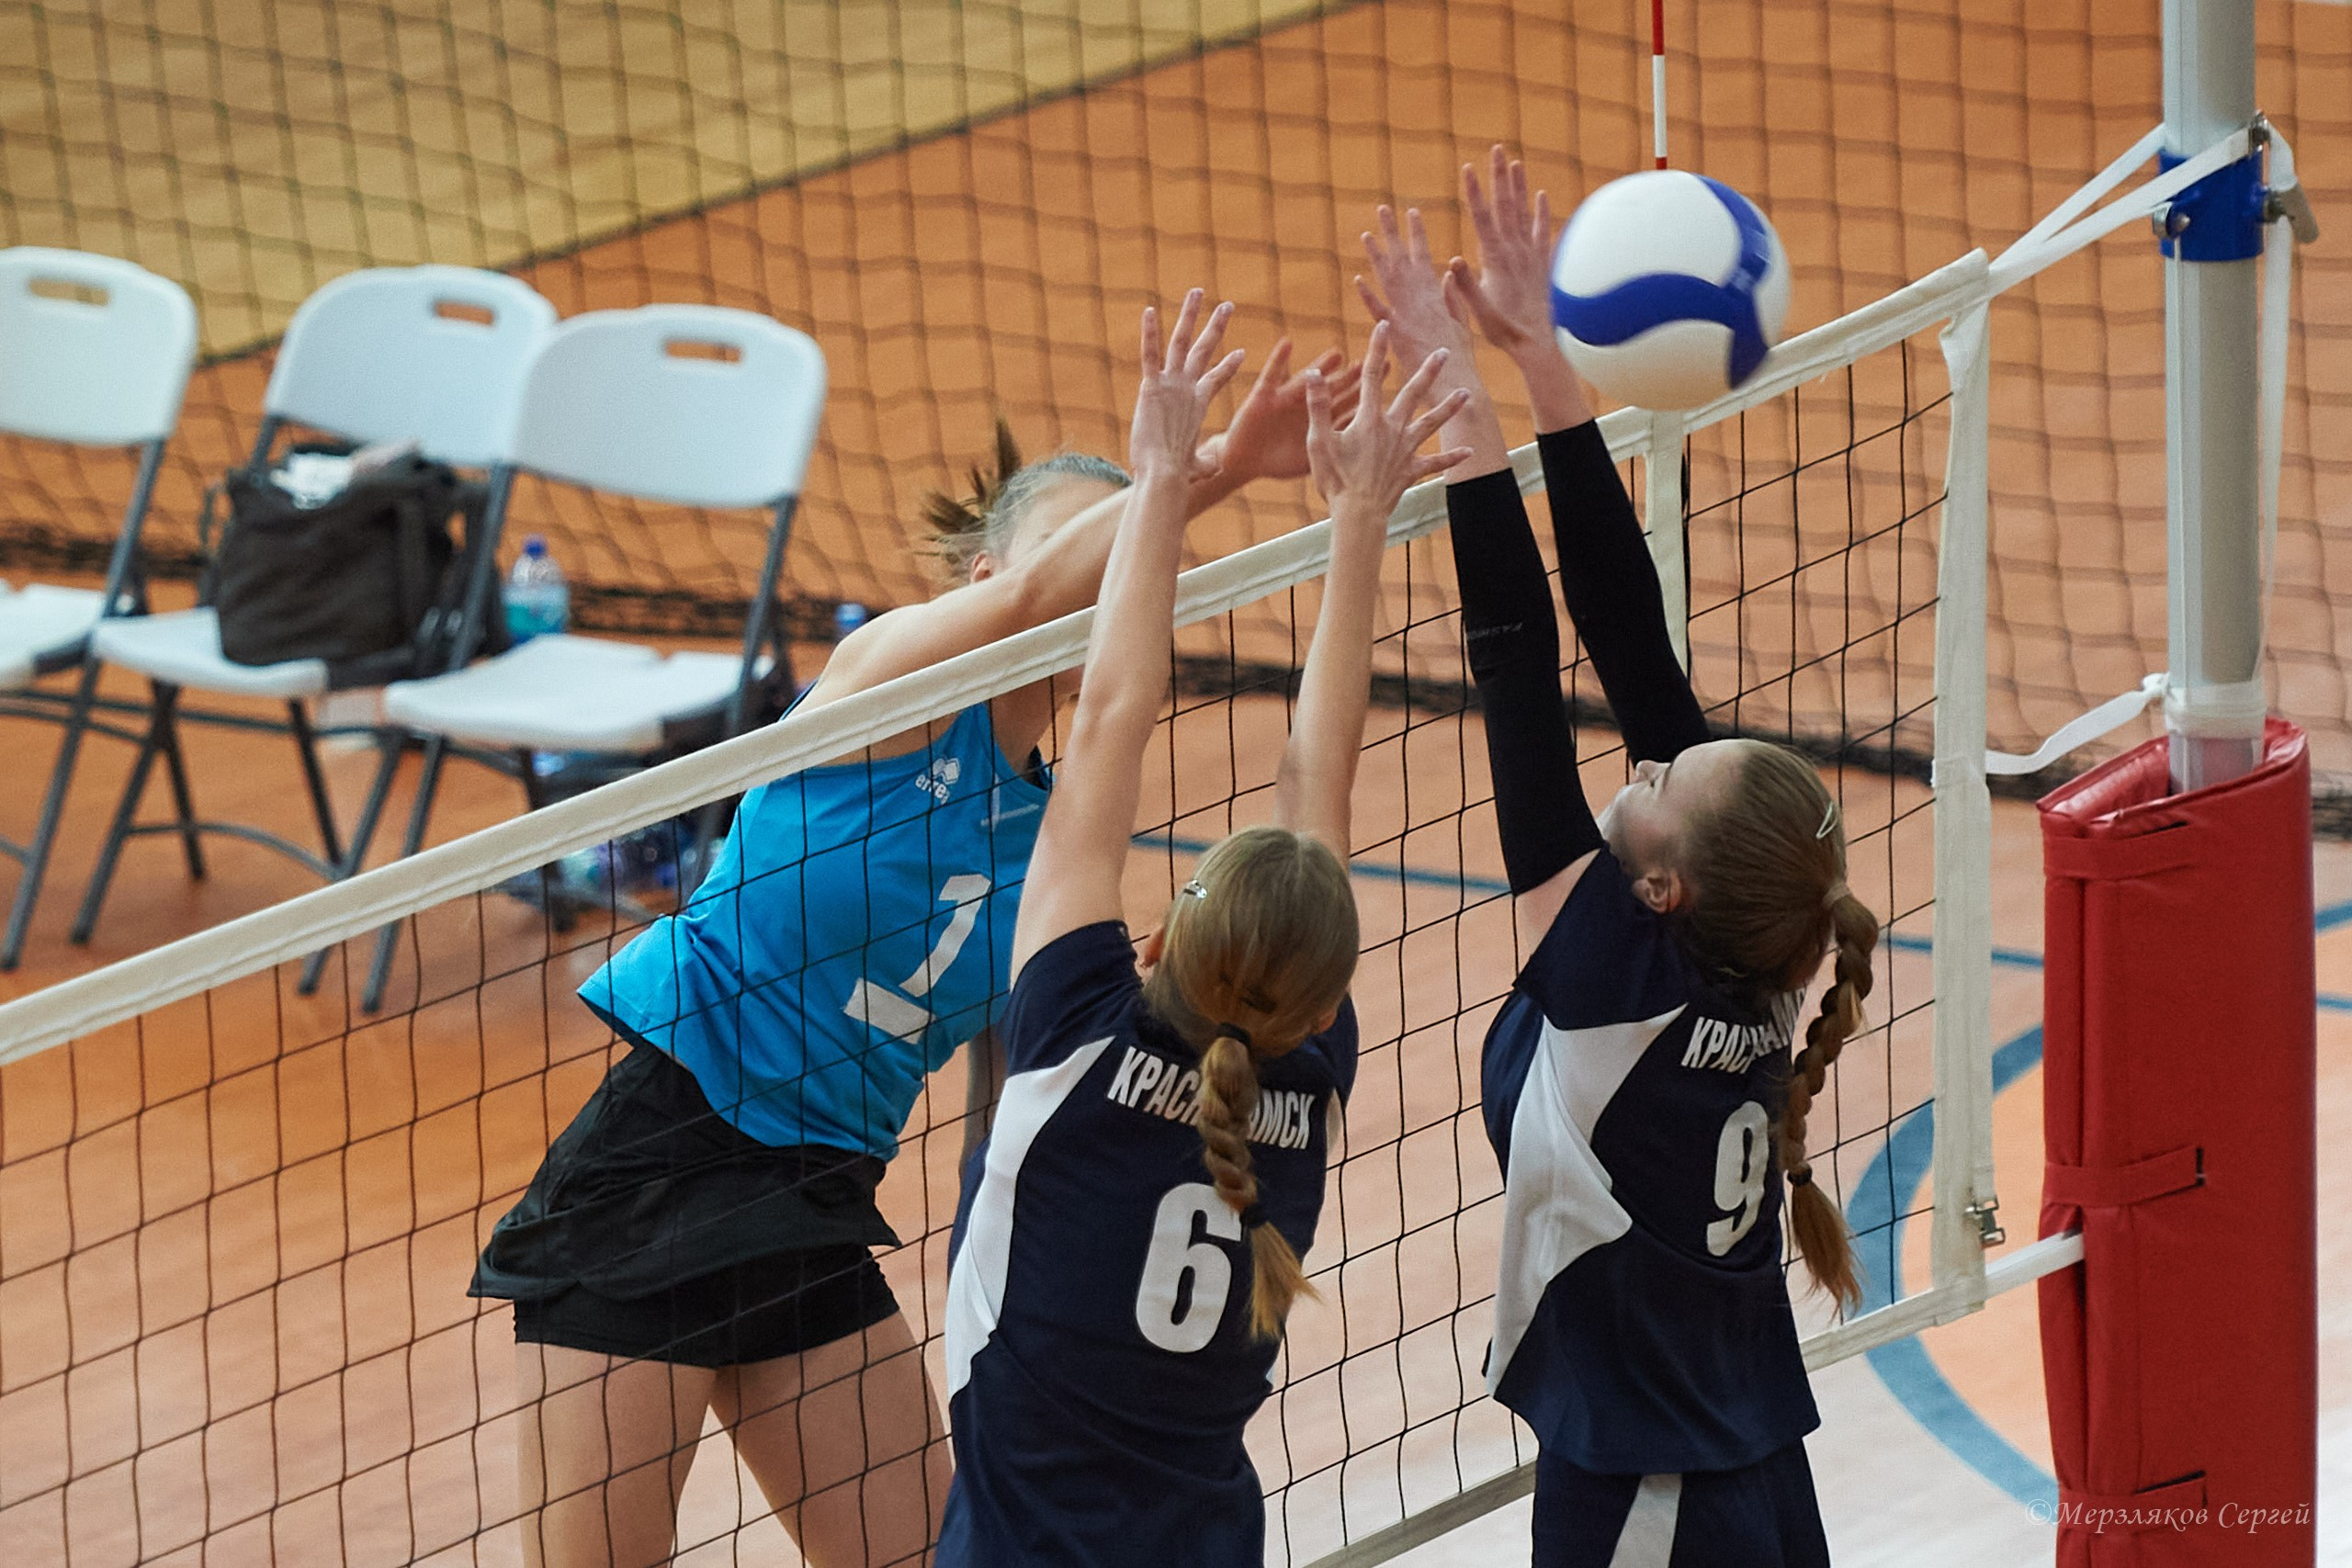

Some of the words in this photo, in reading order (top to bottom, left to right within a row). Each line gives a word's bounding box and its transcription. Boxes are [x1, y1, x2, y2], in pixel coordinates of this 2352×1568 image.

[1107, 1045, 1317, 1150] КРАСМСК
[1706, 1100, 1770, 1258] 9
[1136, 1182, 1242, 1353] 6
